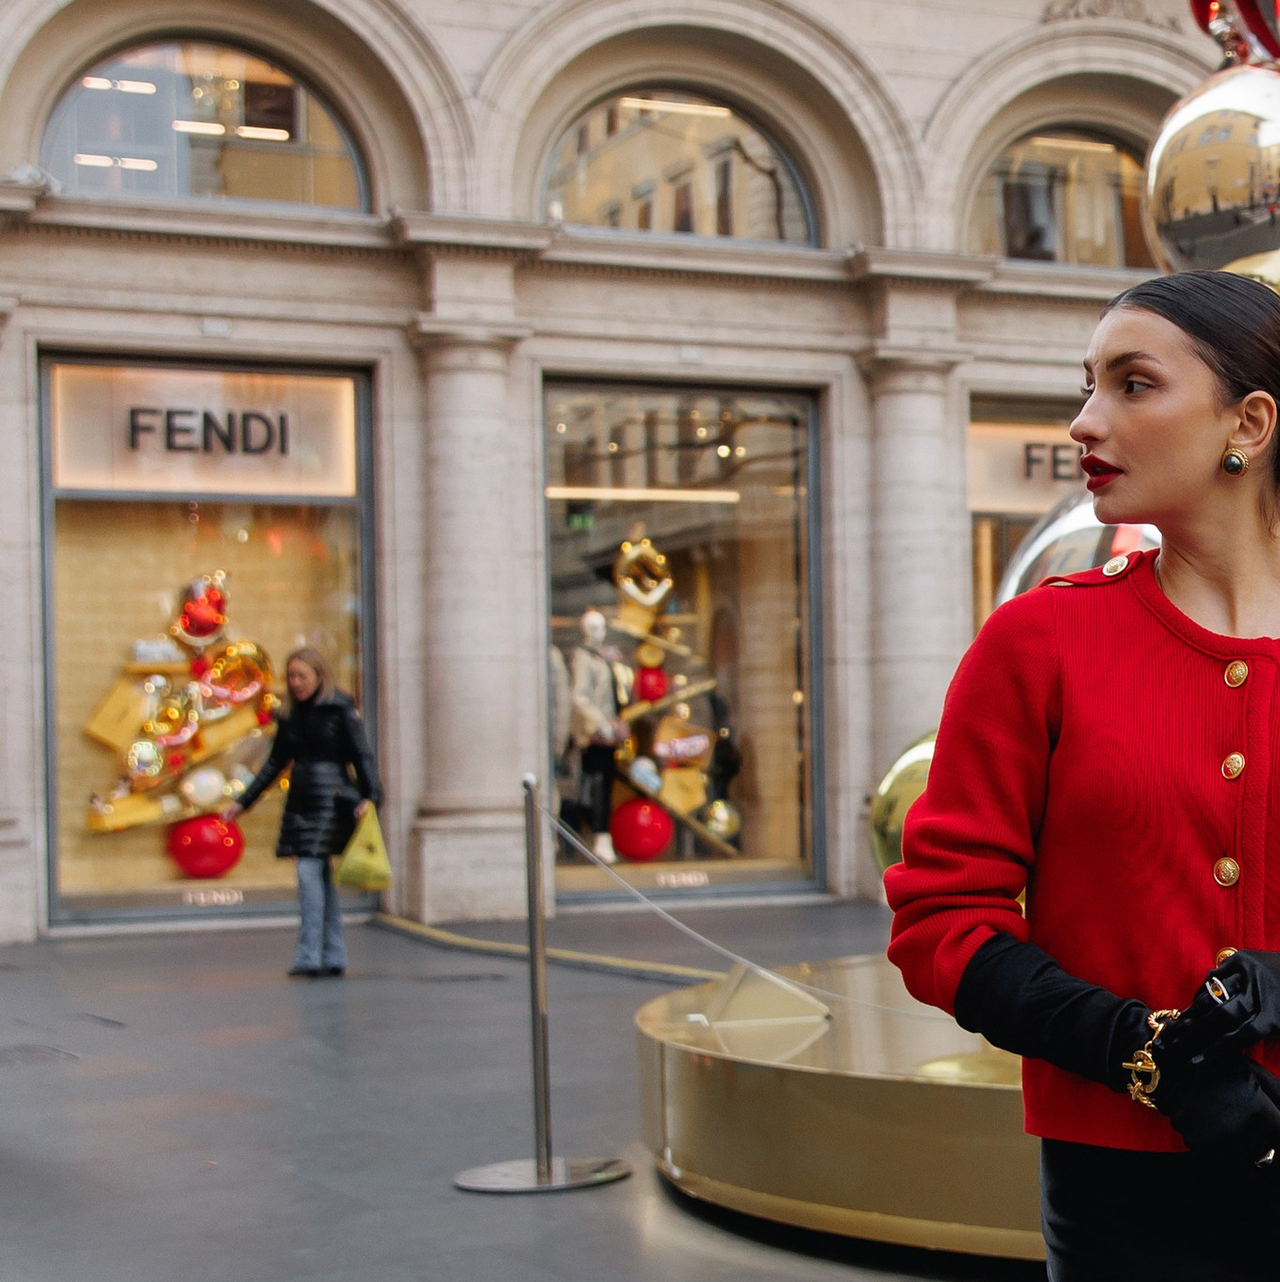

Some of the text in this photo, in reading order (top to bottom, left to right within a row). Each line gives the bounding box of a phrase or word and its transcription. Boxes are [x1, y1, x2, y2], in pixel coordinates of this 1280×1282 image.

[130, 408, 289, 454] FENDI
[1025, 443, 1085, 479] FE
[182, 890, 244, 906] FENDI
